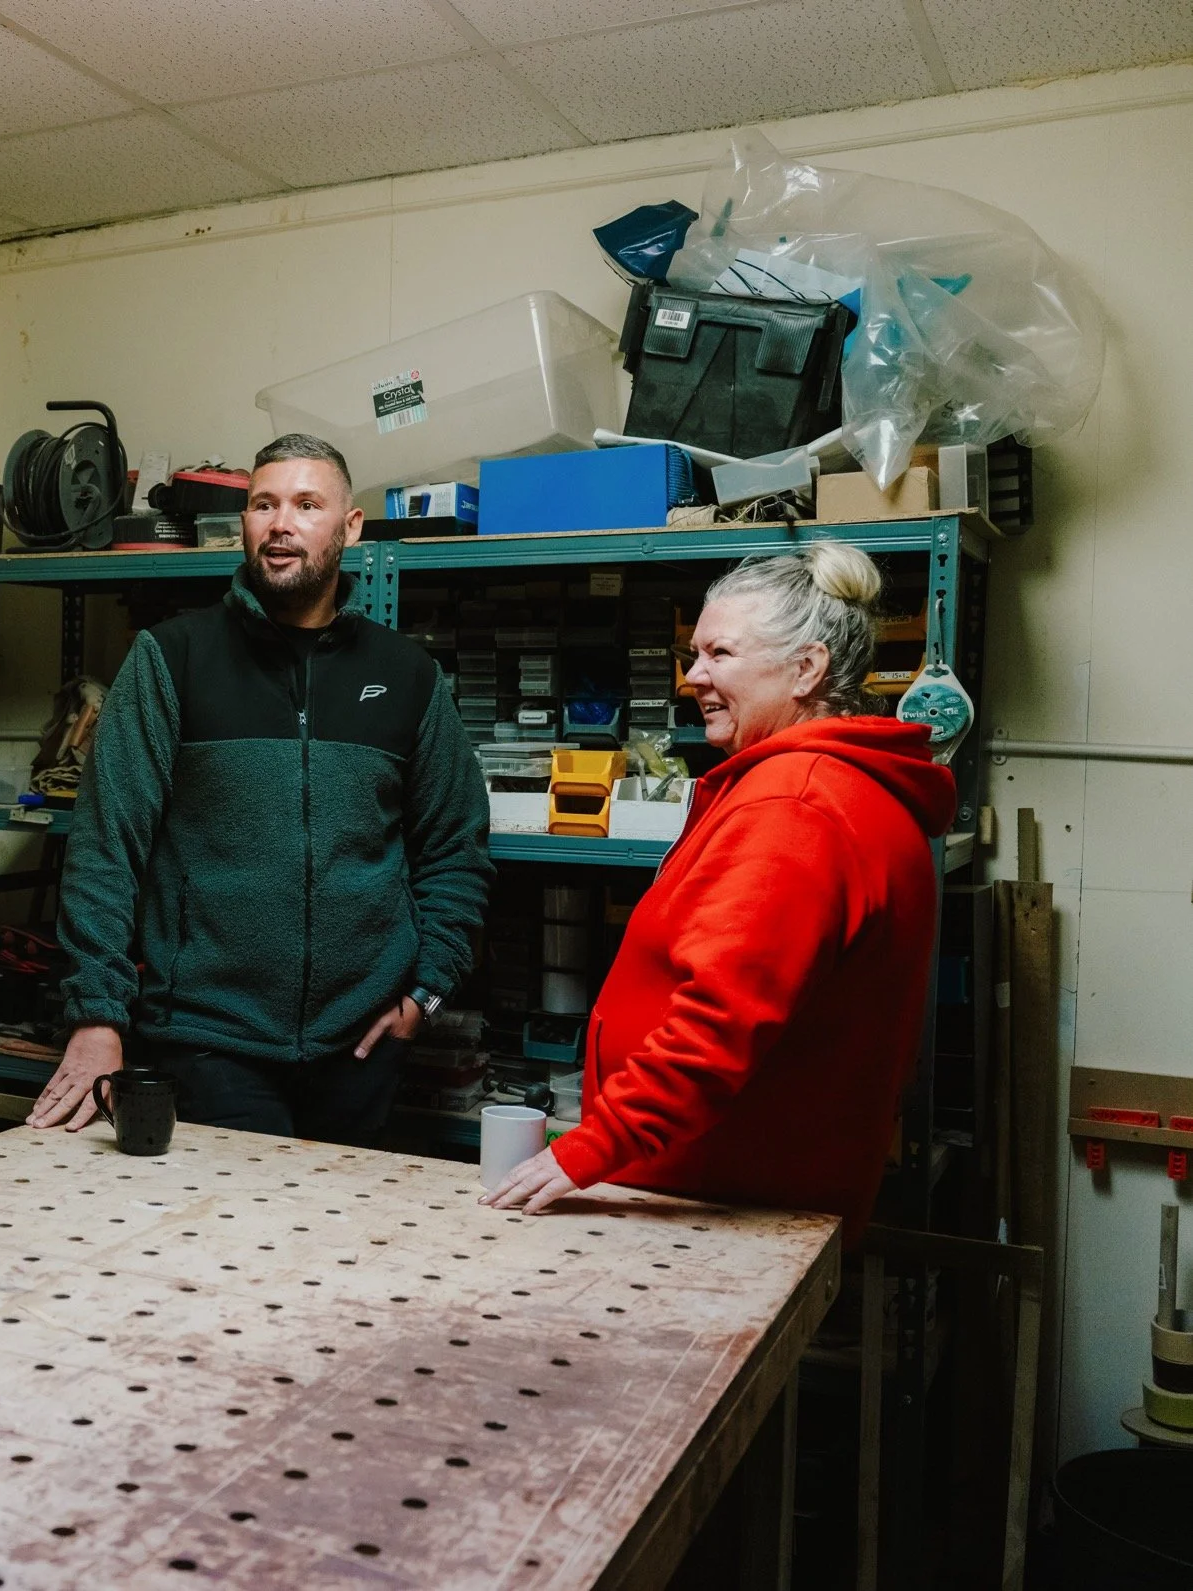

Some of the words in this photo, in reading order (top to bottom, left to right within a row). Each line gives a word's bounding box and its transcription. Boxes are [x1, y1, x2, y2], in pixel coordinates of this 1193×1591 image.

[383, 385, 412, 400] Crystal
[903, 711, 927, 719] Twist
[944, 707, 959, 715] Tie
